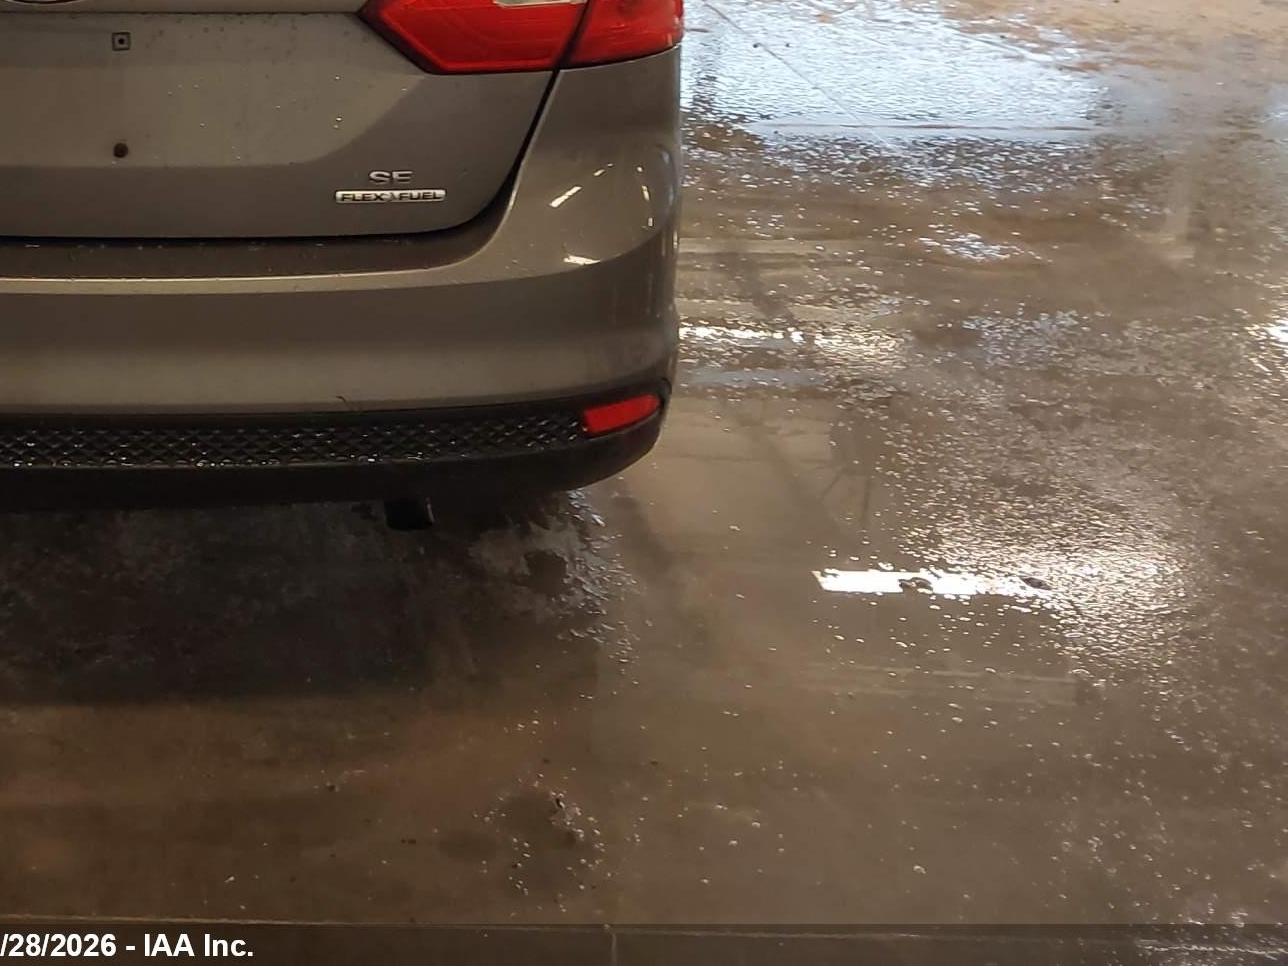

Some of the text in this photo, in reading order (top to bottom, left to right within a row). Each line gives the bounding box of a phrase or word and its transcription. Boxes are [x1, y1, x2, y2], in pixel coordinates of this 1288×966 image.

[368, 170, 414, 185] SE
[341, 191, 444, 202] FLEX FUEL
